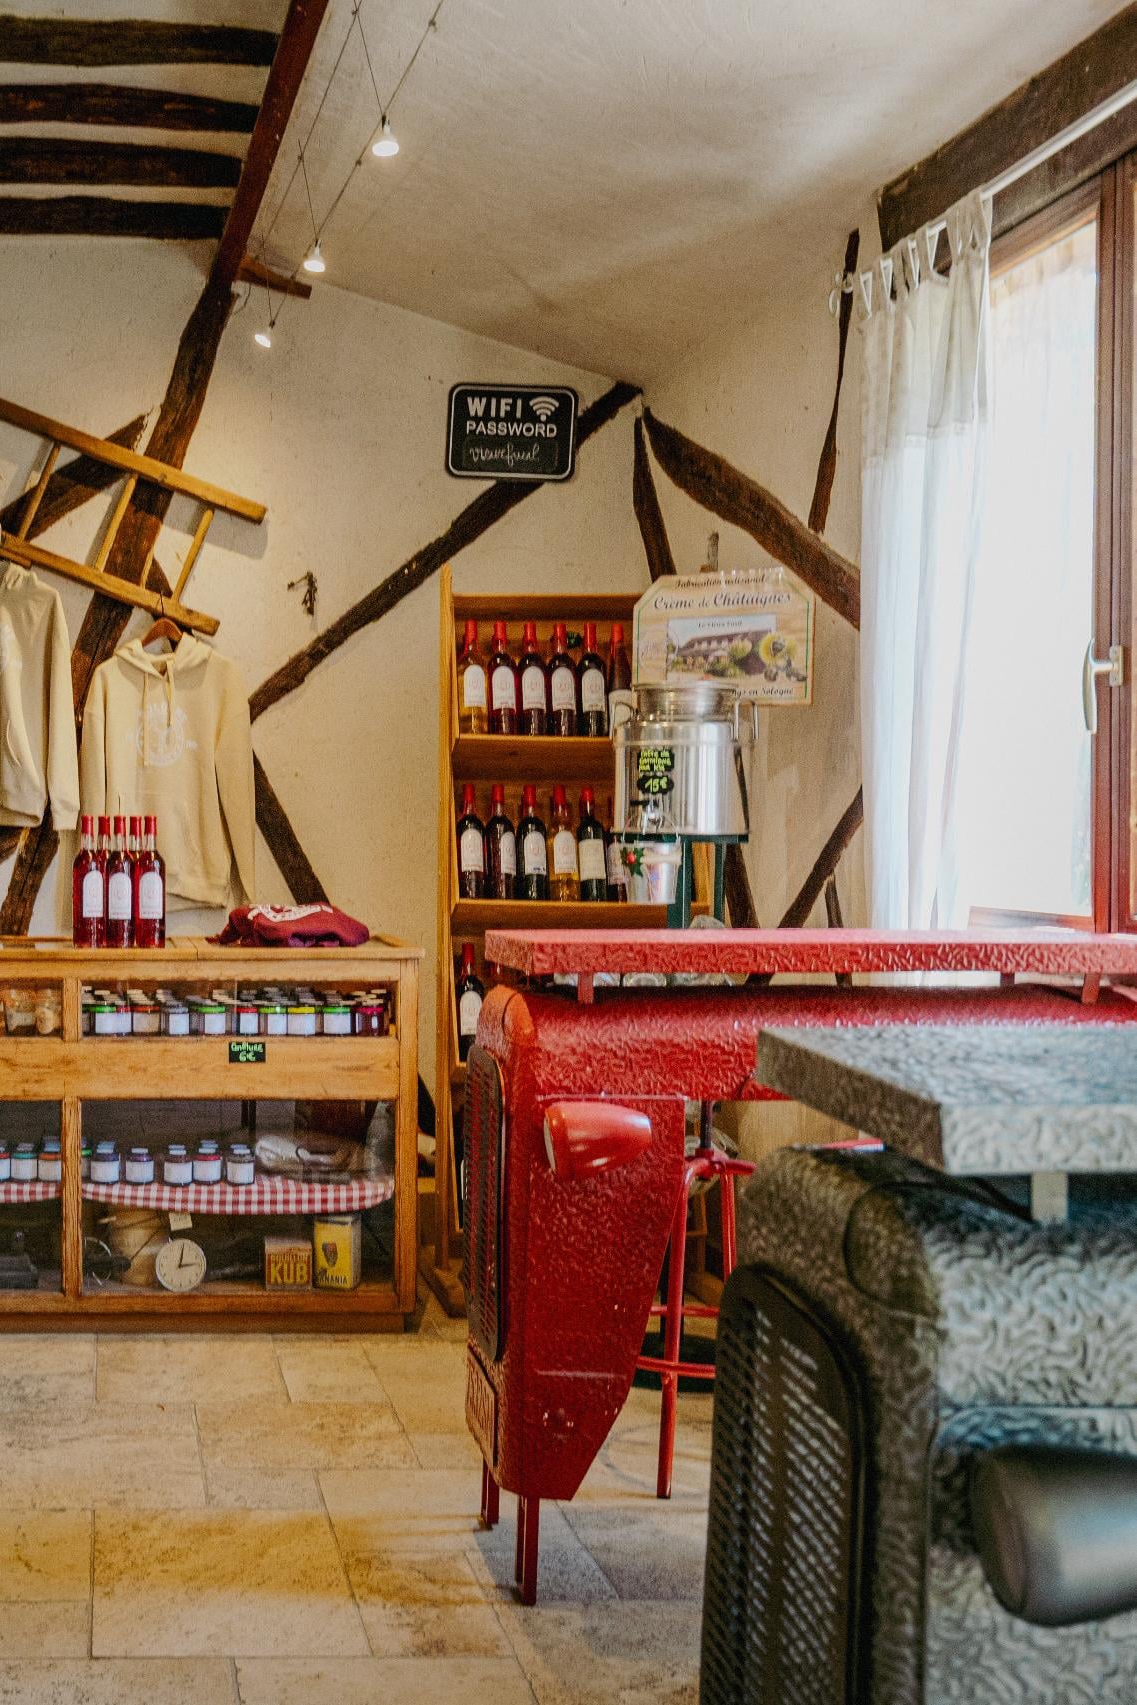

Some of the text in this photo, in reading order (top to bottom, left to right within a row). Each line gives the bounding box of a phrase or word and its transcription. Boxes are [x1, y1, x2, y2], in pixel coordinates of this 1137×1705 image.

[466, 396, 522, 419] WIFI
[466, 420, 557, 438] PASSWORD
[270, 1262, 308, 1285] KUB
